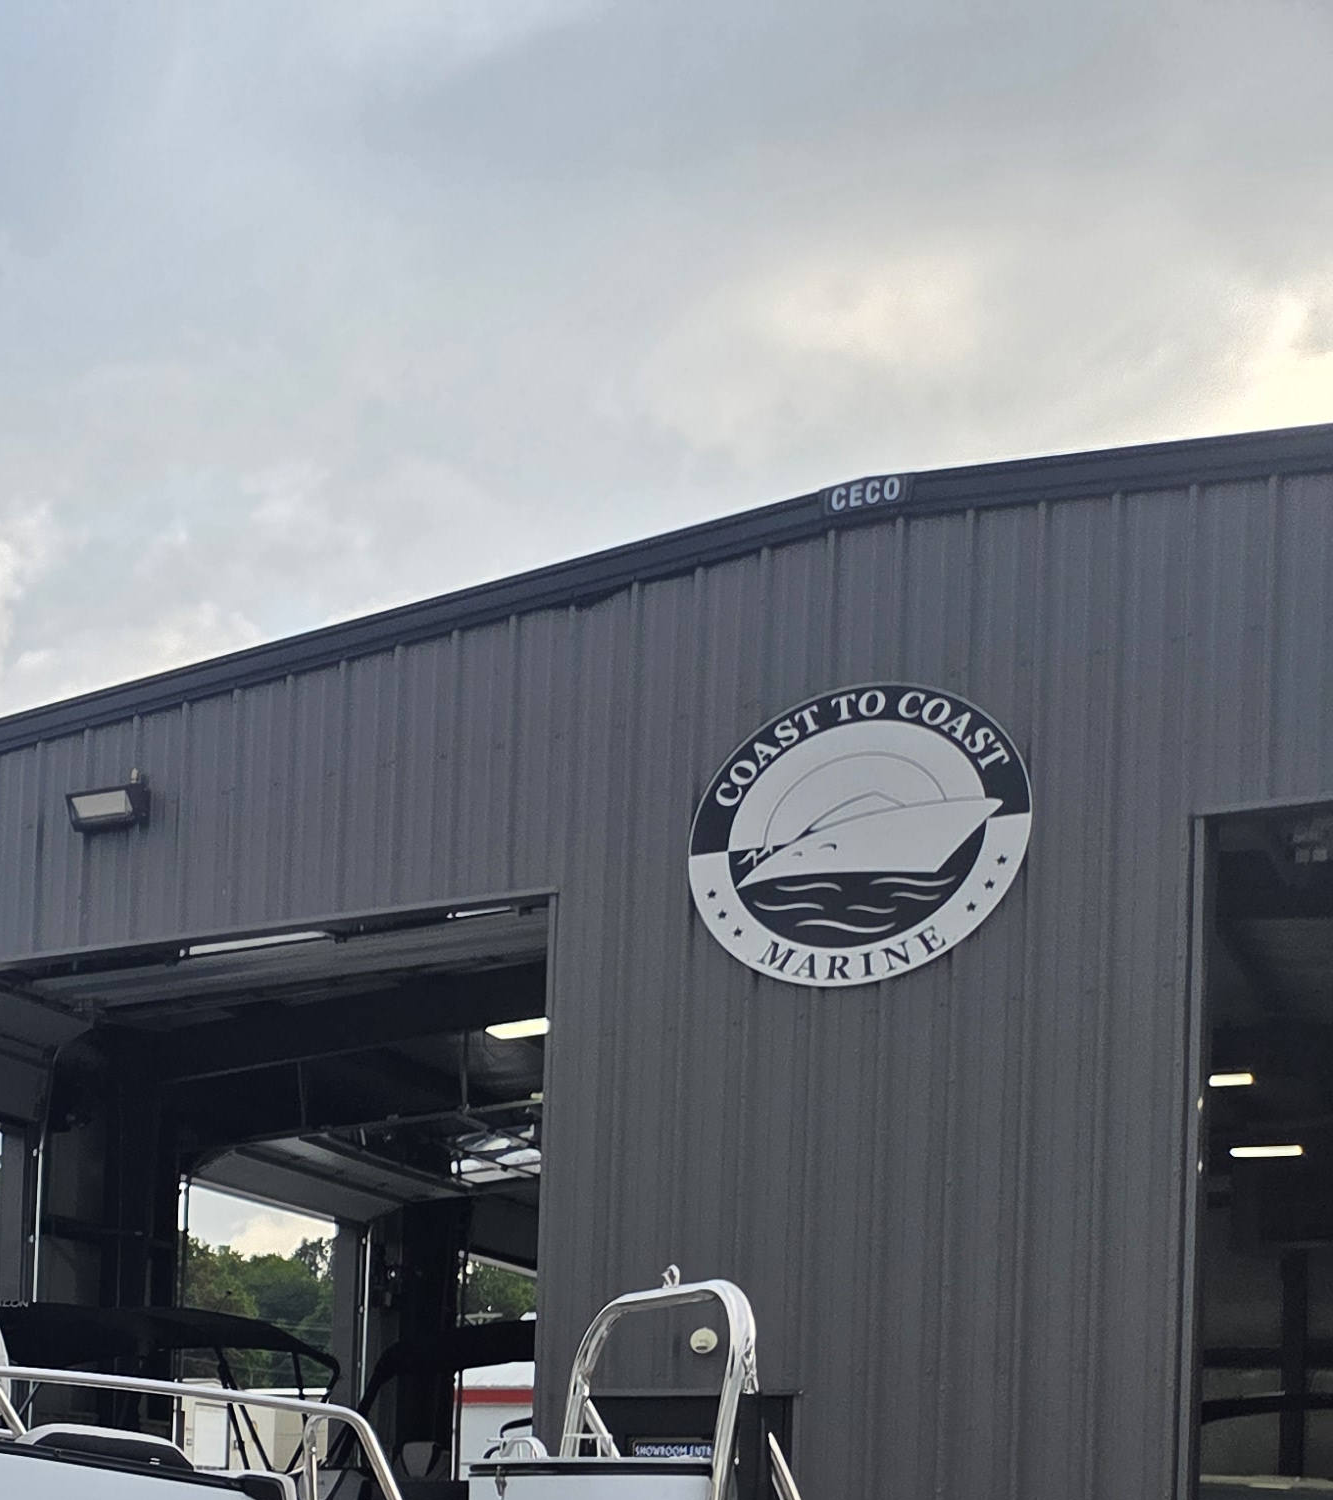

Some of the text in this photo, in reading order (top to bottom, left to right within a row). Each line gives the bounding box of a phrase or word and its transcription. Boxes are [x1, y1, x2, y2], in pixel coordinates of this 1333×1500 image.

[831, 476, 901, 511] CECO
[715, 689, 1010, 808] COAST TO COAST
[756, 925, 948, 981] MARINE
[635, 1444, 687, 1457] SHOWROOM
